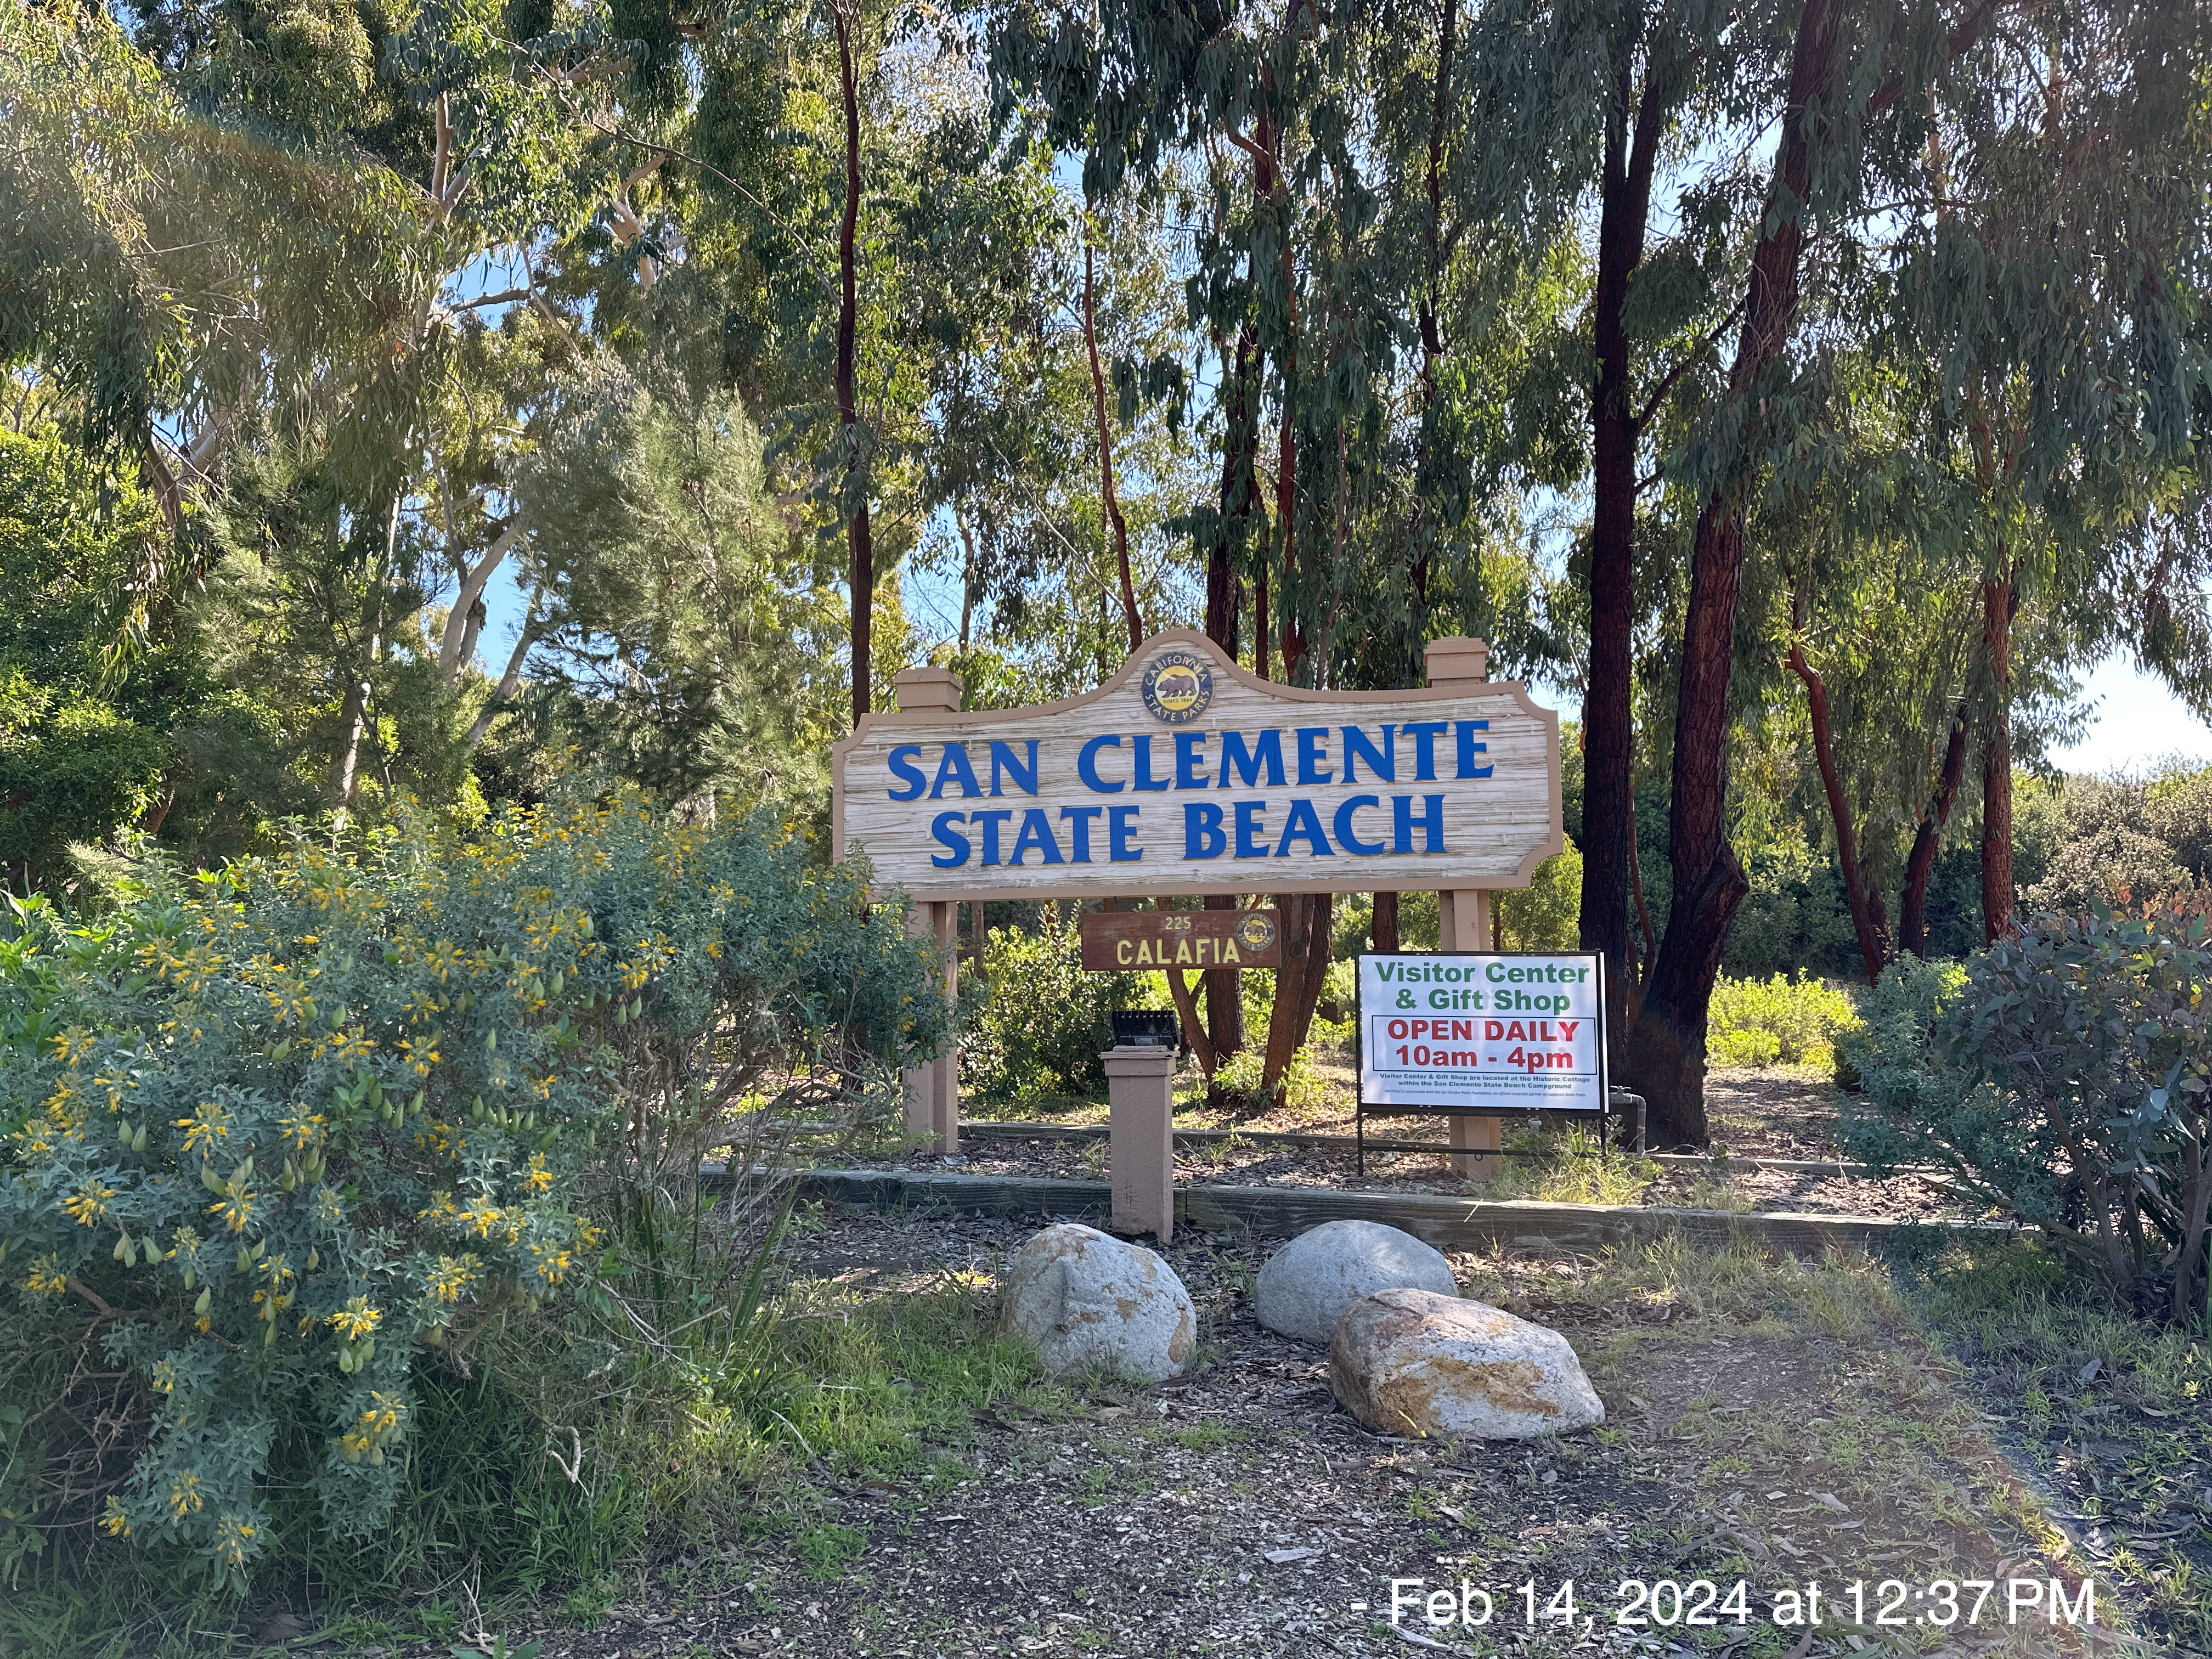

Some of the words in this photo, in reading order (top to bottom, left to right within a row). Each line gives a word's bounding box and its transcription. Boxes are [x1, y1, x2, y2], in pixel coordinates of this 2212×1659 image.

[1146, 655, 1208, 686] CALIFORNIA
[1145, 693, 1176, 721] STATE
[1182, 690, 1210, 720] PARKS
[888, 740, 1039, 801] SAN
[1077, 720, 1494, 793] CLEMENTE
[932, 805, 1142, 868] STATE
[1184, 794, 1447, 859] BEACH
[1165, 917, 1191, 930] 225
[1117, 938, 1240, 964] CALAFIA
[1375, 962, 1475, 982] Visitor
[1486, 962, 1590, 983] Center
[1396, 989, 1417, 1009] &
[1429, 989, 1483, 1010] Gift
[1494, 990, 1571, 1015] Shop
[1388, 1019, 1472, 1040] OPEN
[1485, 1020, 1579, 1041] DAILY
[1396, 1045, 1477, 1066] 10am
[1507, 1047, 1573, 1073] 4pm
